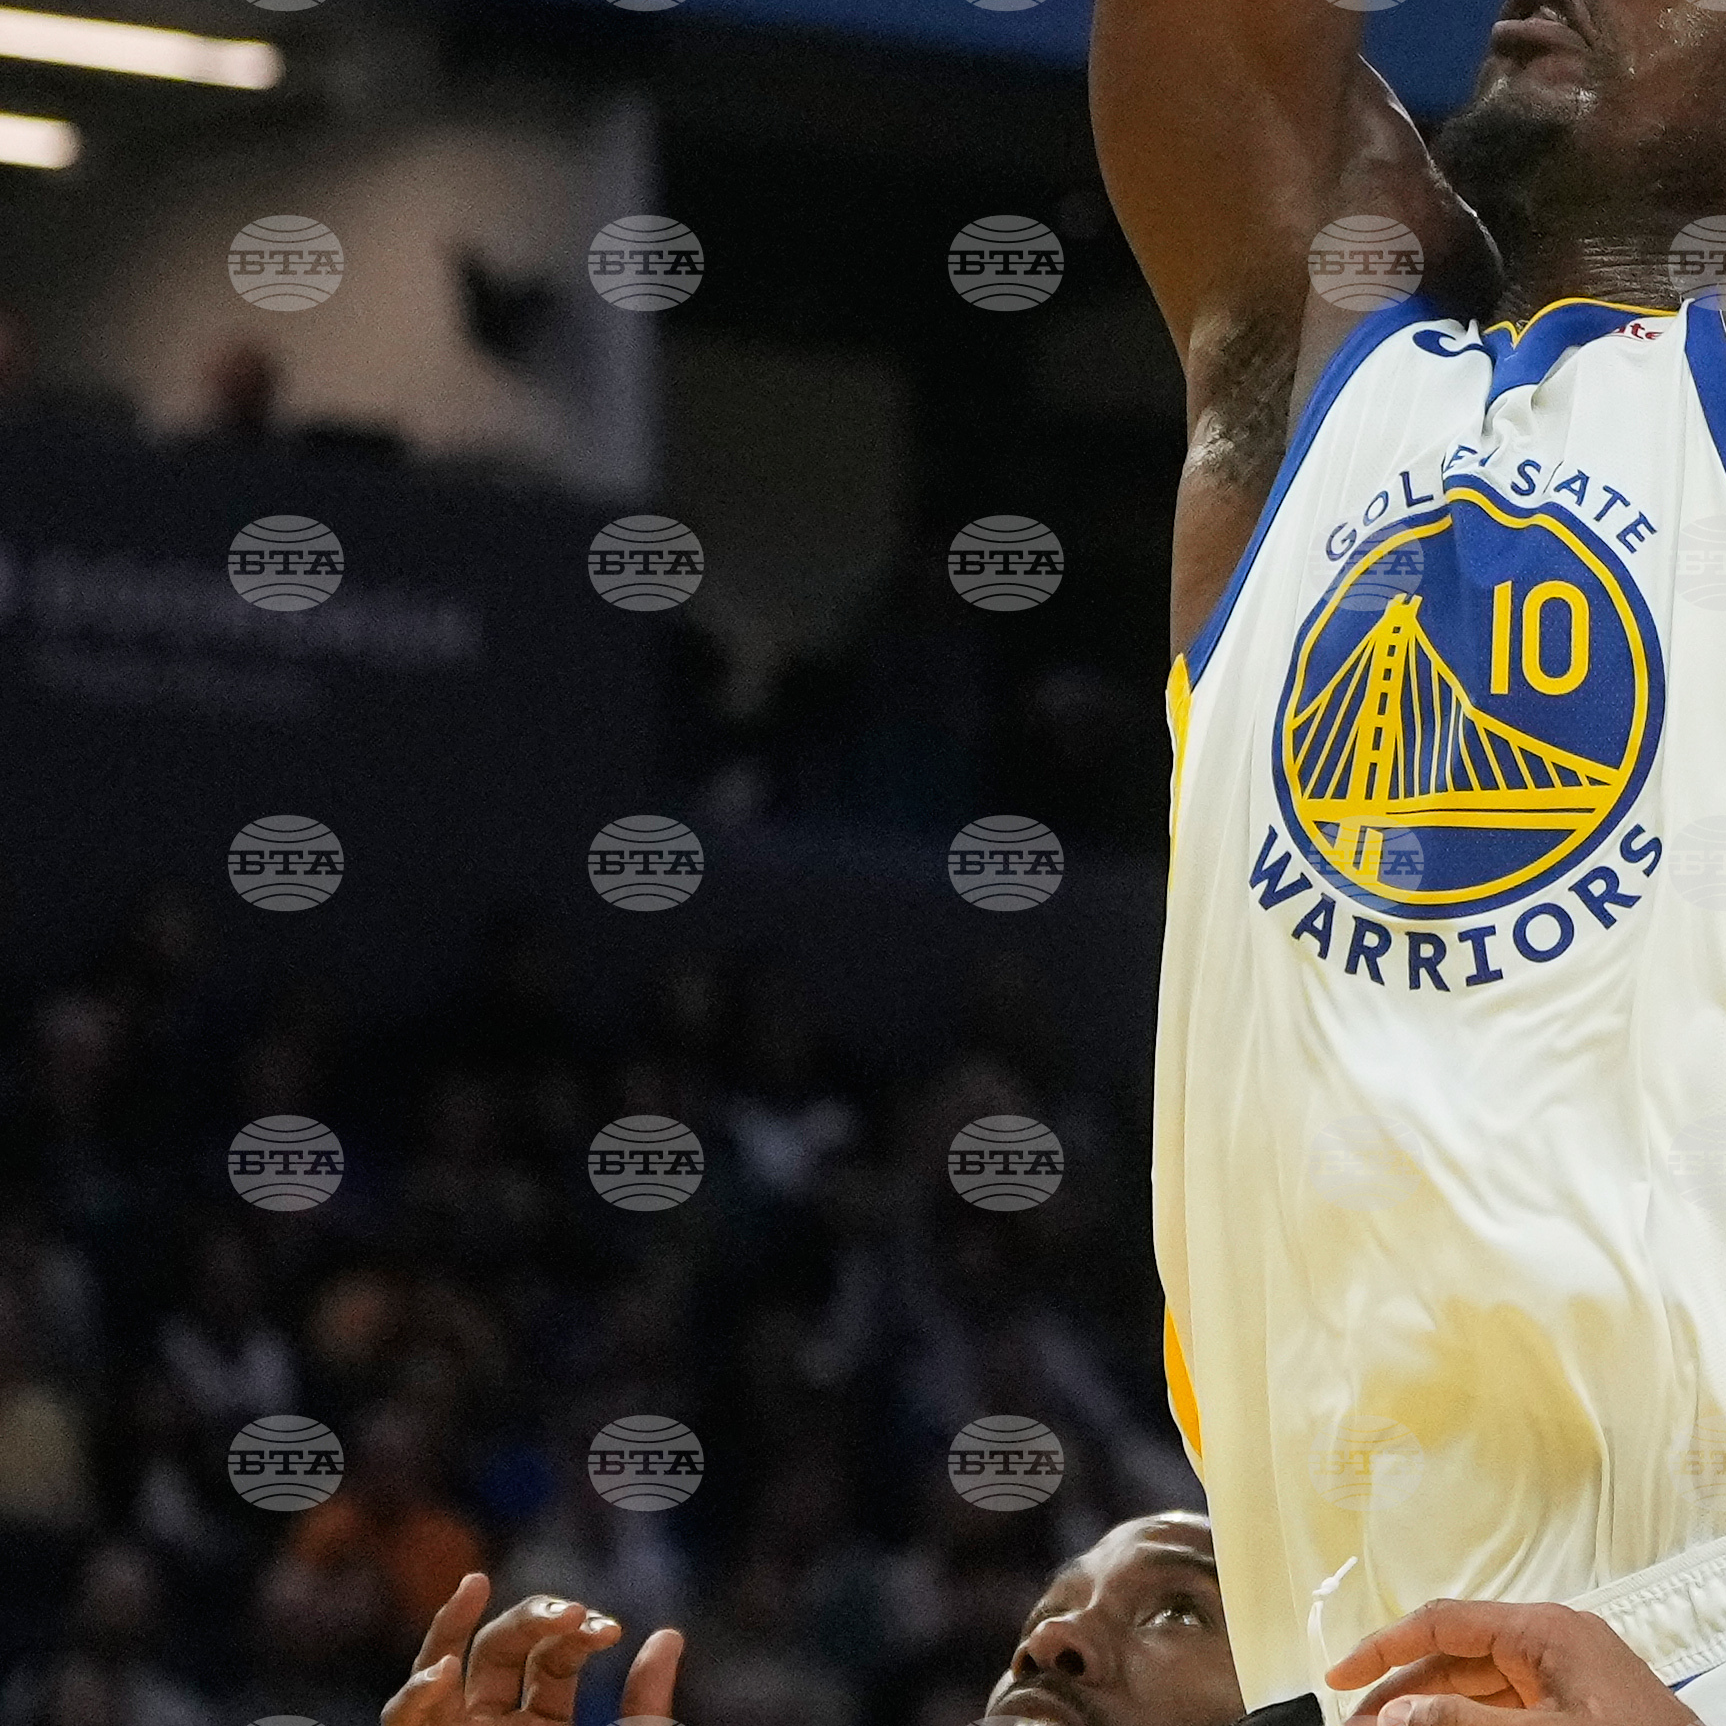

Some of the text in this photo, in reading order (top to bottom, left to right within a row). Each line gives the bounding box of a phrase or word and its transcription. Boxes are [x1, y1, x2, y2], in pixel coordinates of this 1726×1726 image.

[1325, 445, 1657, 562] GOLE SATE
[1490, 580, 1590, 696] 10
[1248, 824, 1664, 993] WARRIORS
